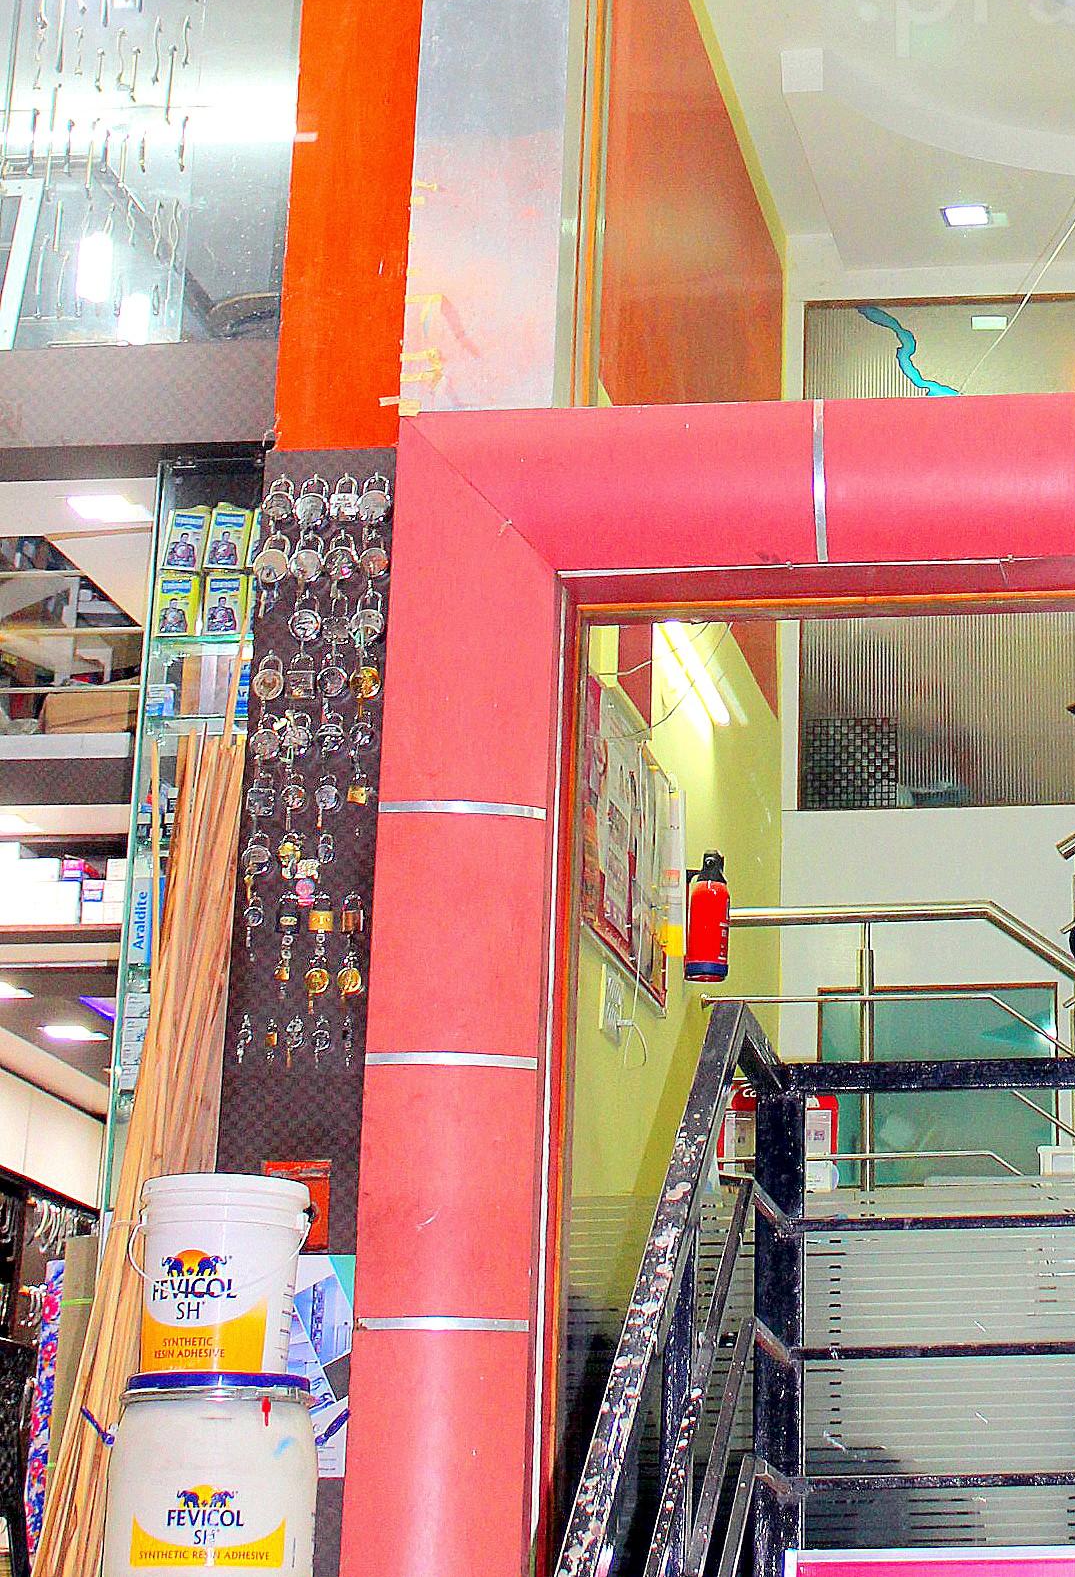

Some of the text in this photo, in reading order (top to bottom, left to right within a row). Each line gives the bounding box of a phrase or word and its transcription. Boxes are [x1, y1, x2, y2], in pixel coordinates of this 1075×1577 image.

[132, 892, 148, 950] Araldite
[152, 1278, 238, 1301] FEVICOL
[176, 1301, 200, 1320] SH
[162, 1336, 213, 1347] SYNTHETIC
[176, 1348, 225, 1359] ADHESIVE
[166, 1509, 245, 1527] FEVICOL
[138, 1549, 189, 1560] SYNTHETIC
[223, 1550, 270, 1561] ADHESIVE
